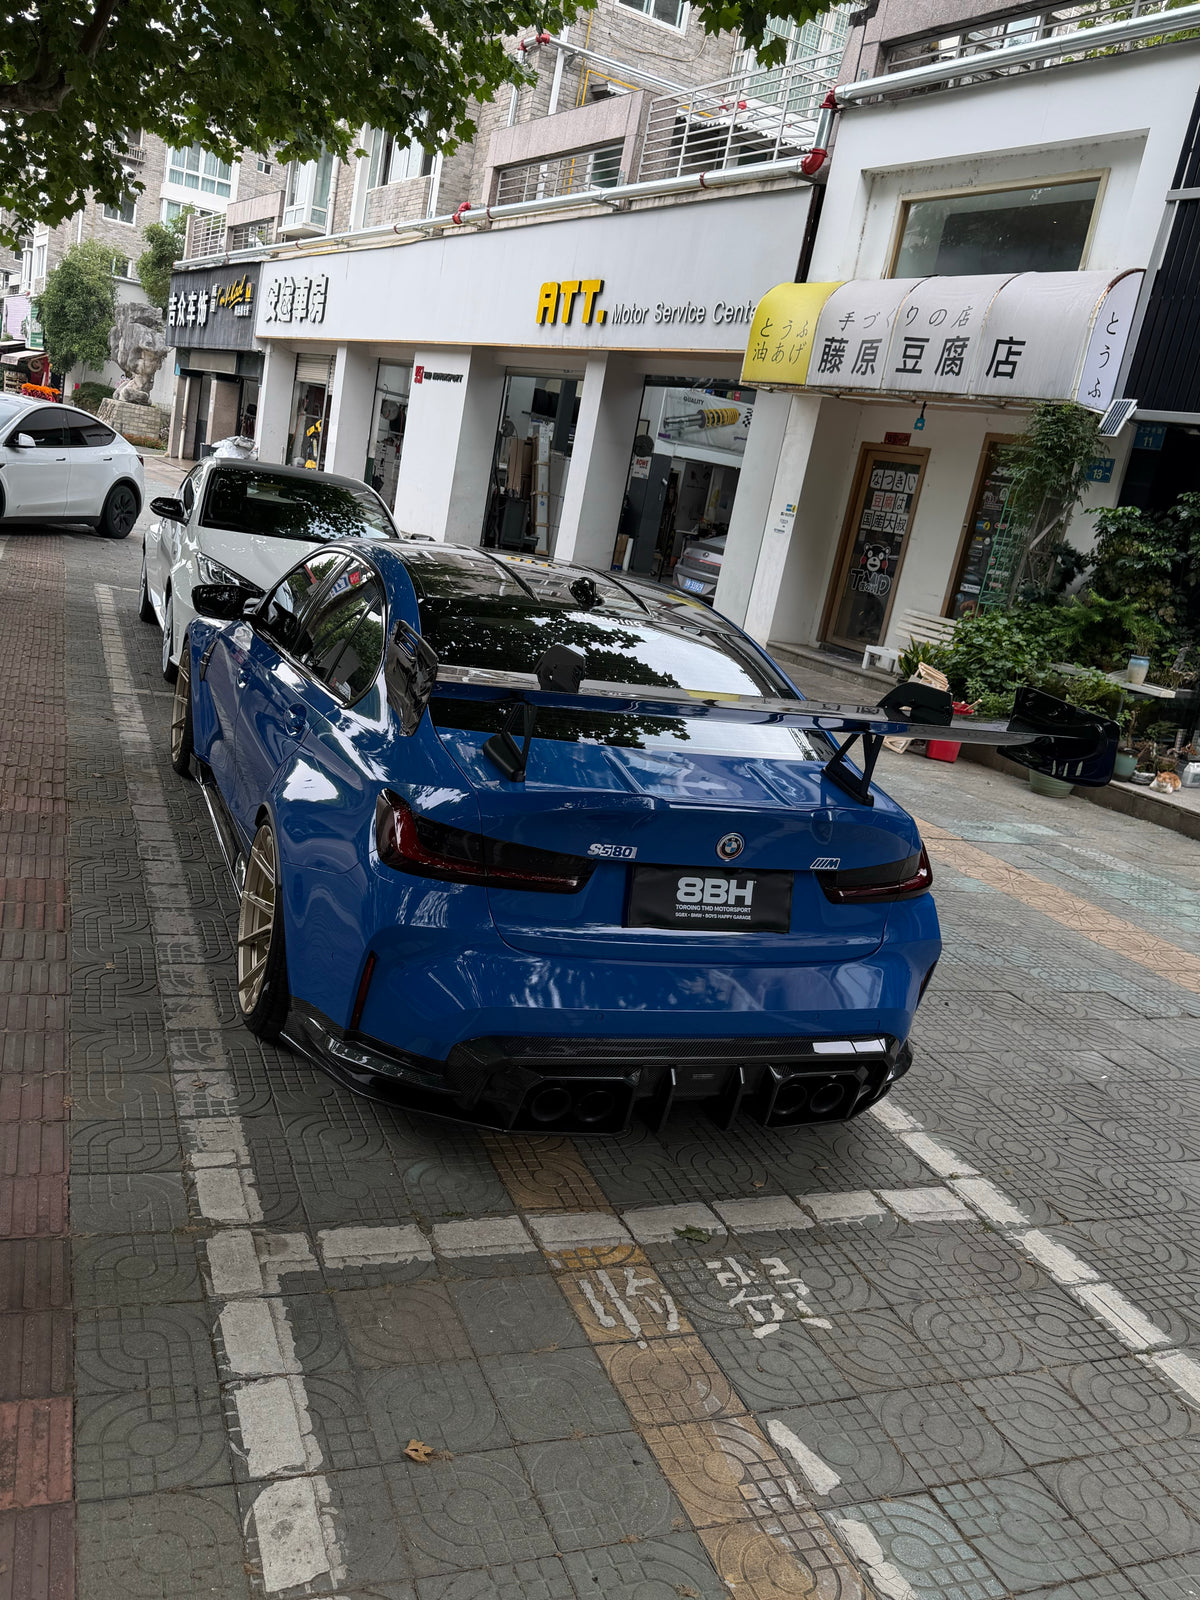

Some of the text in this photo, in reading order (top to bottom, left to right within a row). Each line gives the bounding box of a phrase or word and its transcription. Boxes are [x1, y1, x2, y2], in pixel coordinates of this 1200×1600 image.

[611, 303, 650, 325] Motor
[654, 300, 706, 325] Service
[838, 305, 974, 332] 手づくりの店
[760, 317, 809, 341] とうふ
[752, 341, 808, 365] 油あげ
[817, 335, 1027, 380] 藤原豆腐店
[1087, 311, 1119, 398] とうふ
[683, 396, 705, 406] QUALITY
[1144, 436, 1153, 447] 11
[1093, 468, 1103, 480] 13
[872, 493, 906, 510] 豆腐は
[676, 876, 754, 906] 8BH
